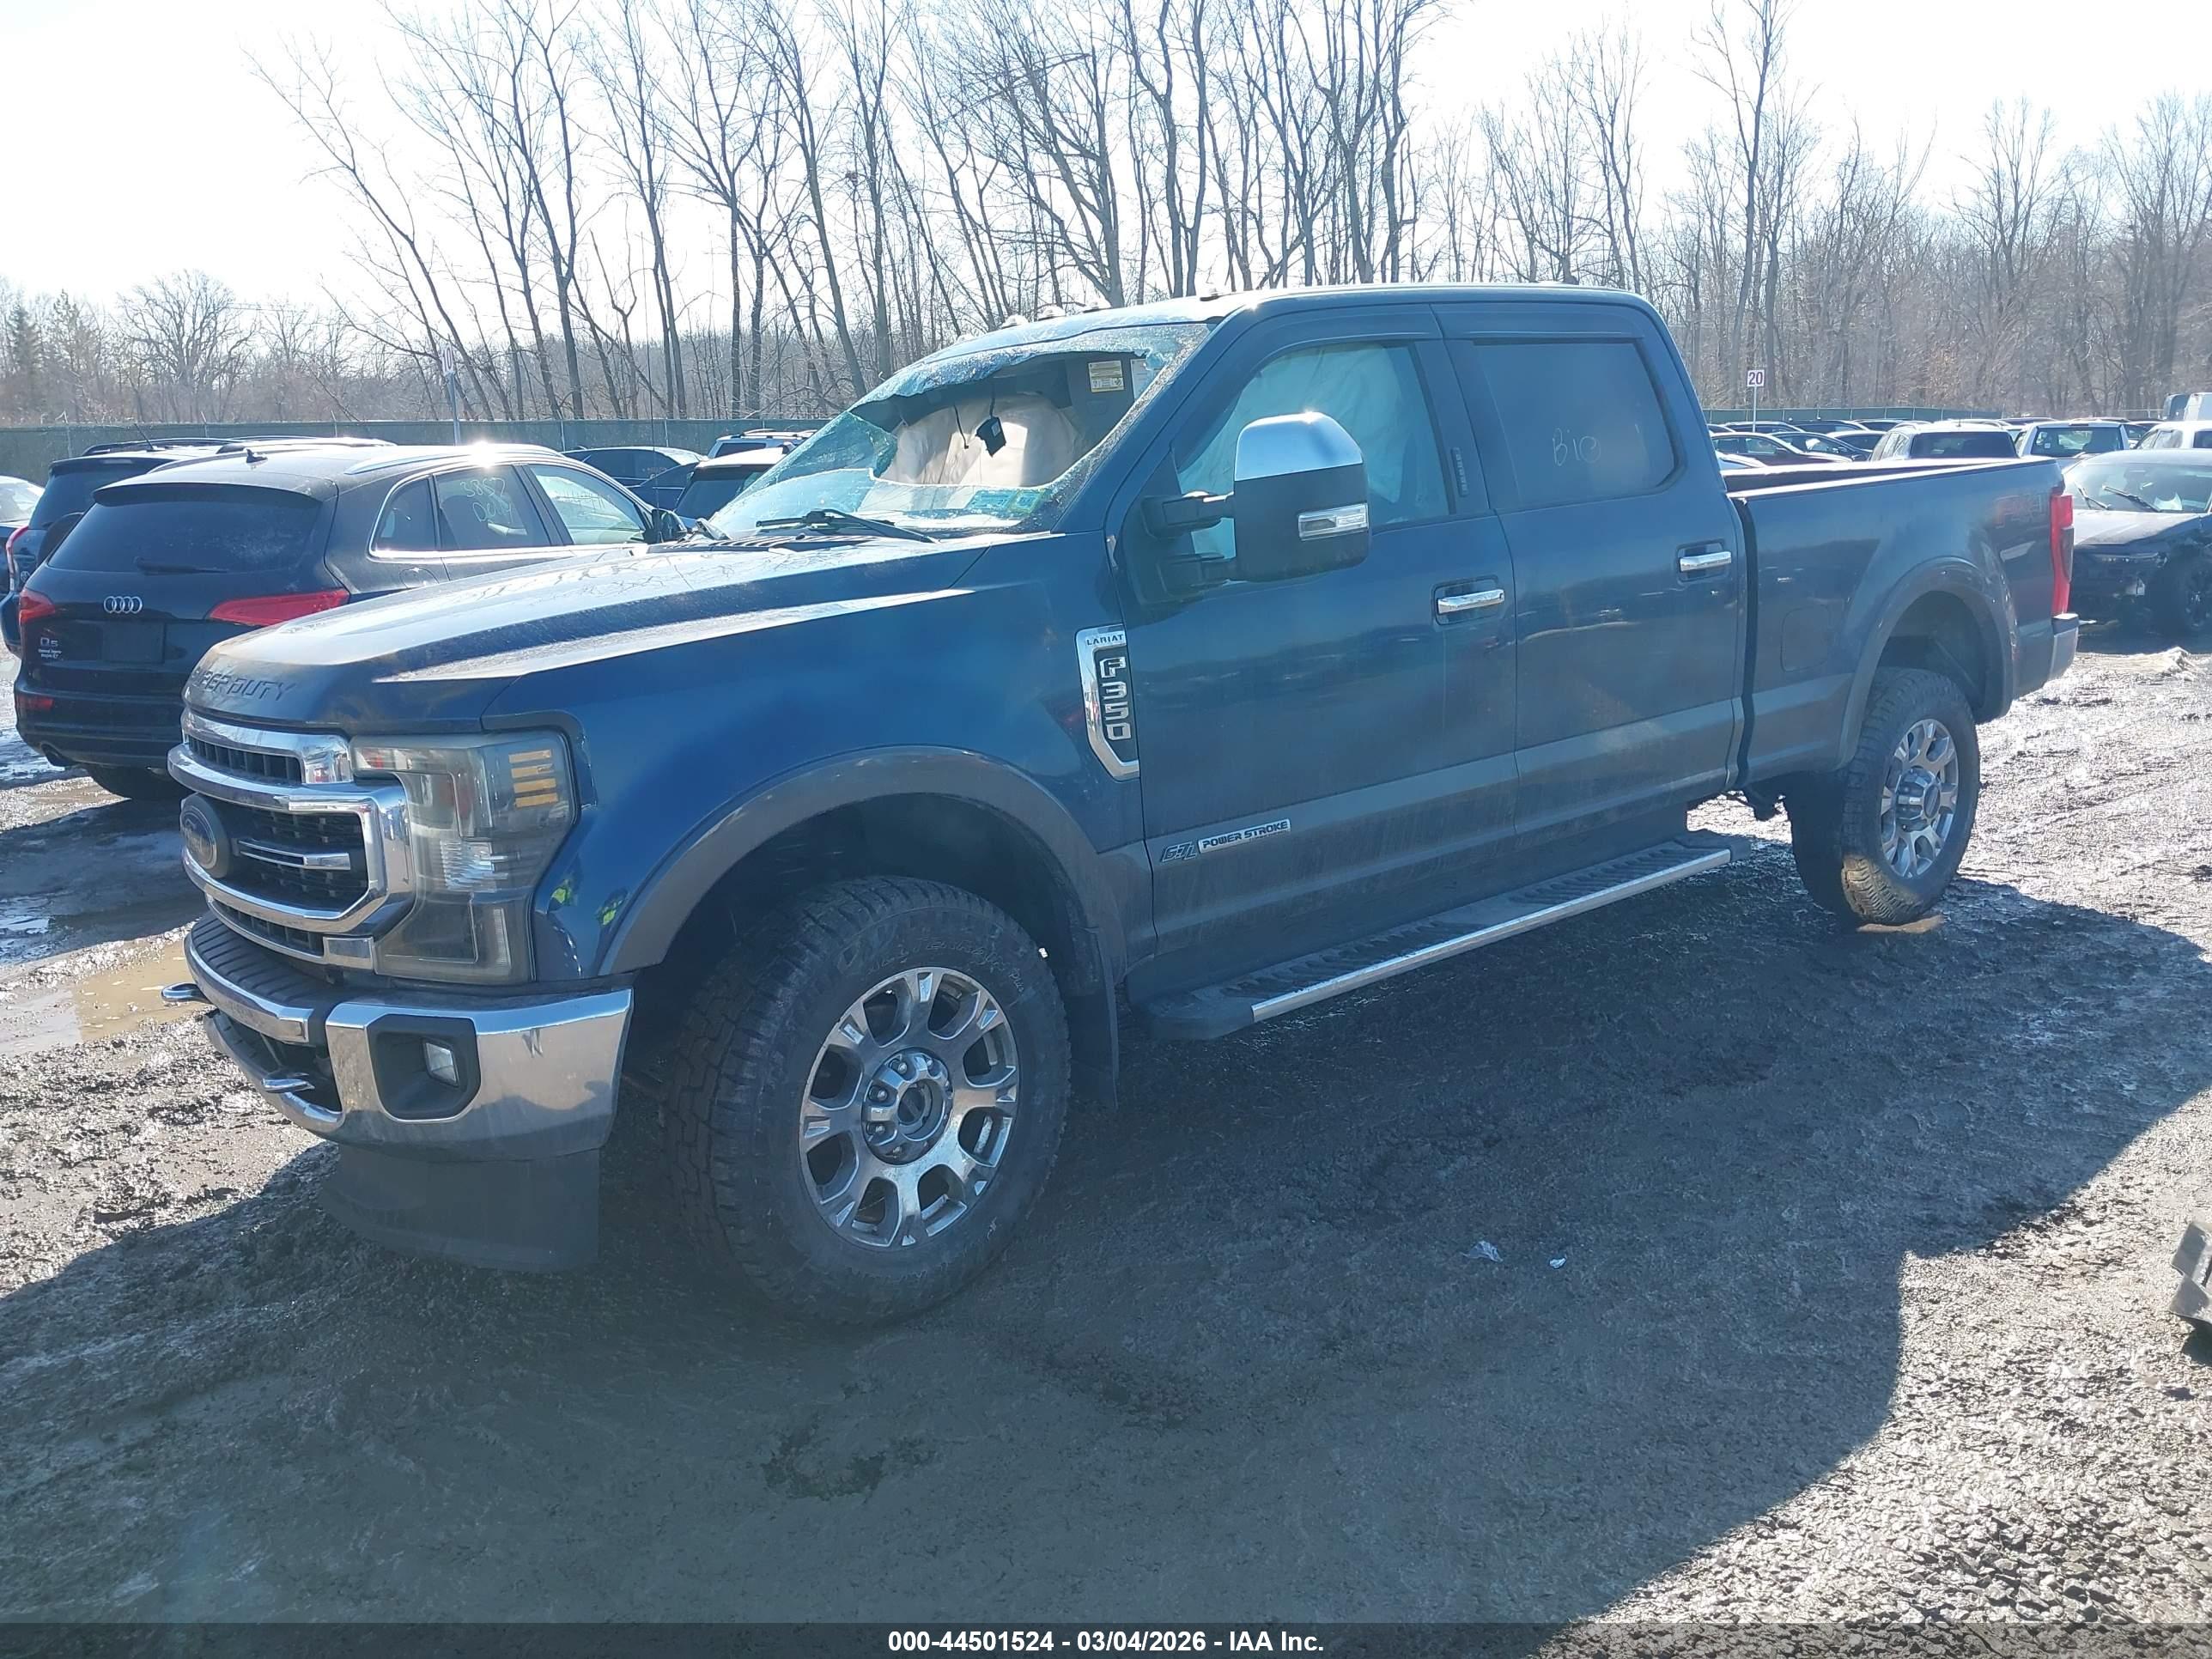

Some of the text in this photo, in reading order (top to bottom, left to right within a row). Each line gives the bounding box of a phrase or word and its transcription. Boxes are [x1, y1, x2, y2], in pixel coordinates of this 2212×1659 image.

[443, 346, 454, 373] 10
[1748, 371, 1763, 385] 20
[459, 477, 506, 497] 3857
[40, 636, 59, 647] Q5
[1085, 634, 1125, 646] LARIAT
[226, 677, 297, 702] DUTY
[1098, 655, 1133, 742] F350
[1201, 832, 1243, 849] POWER
[1243, 820, 1290, 840] STROKE
